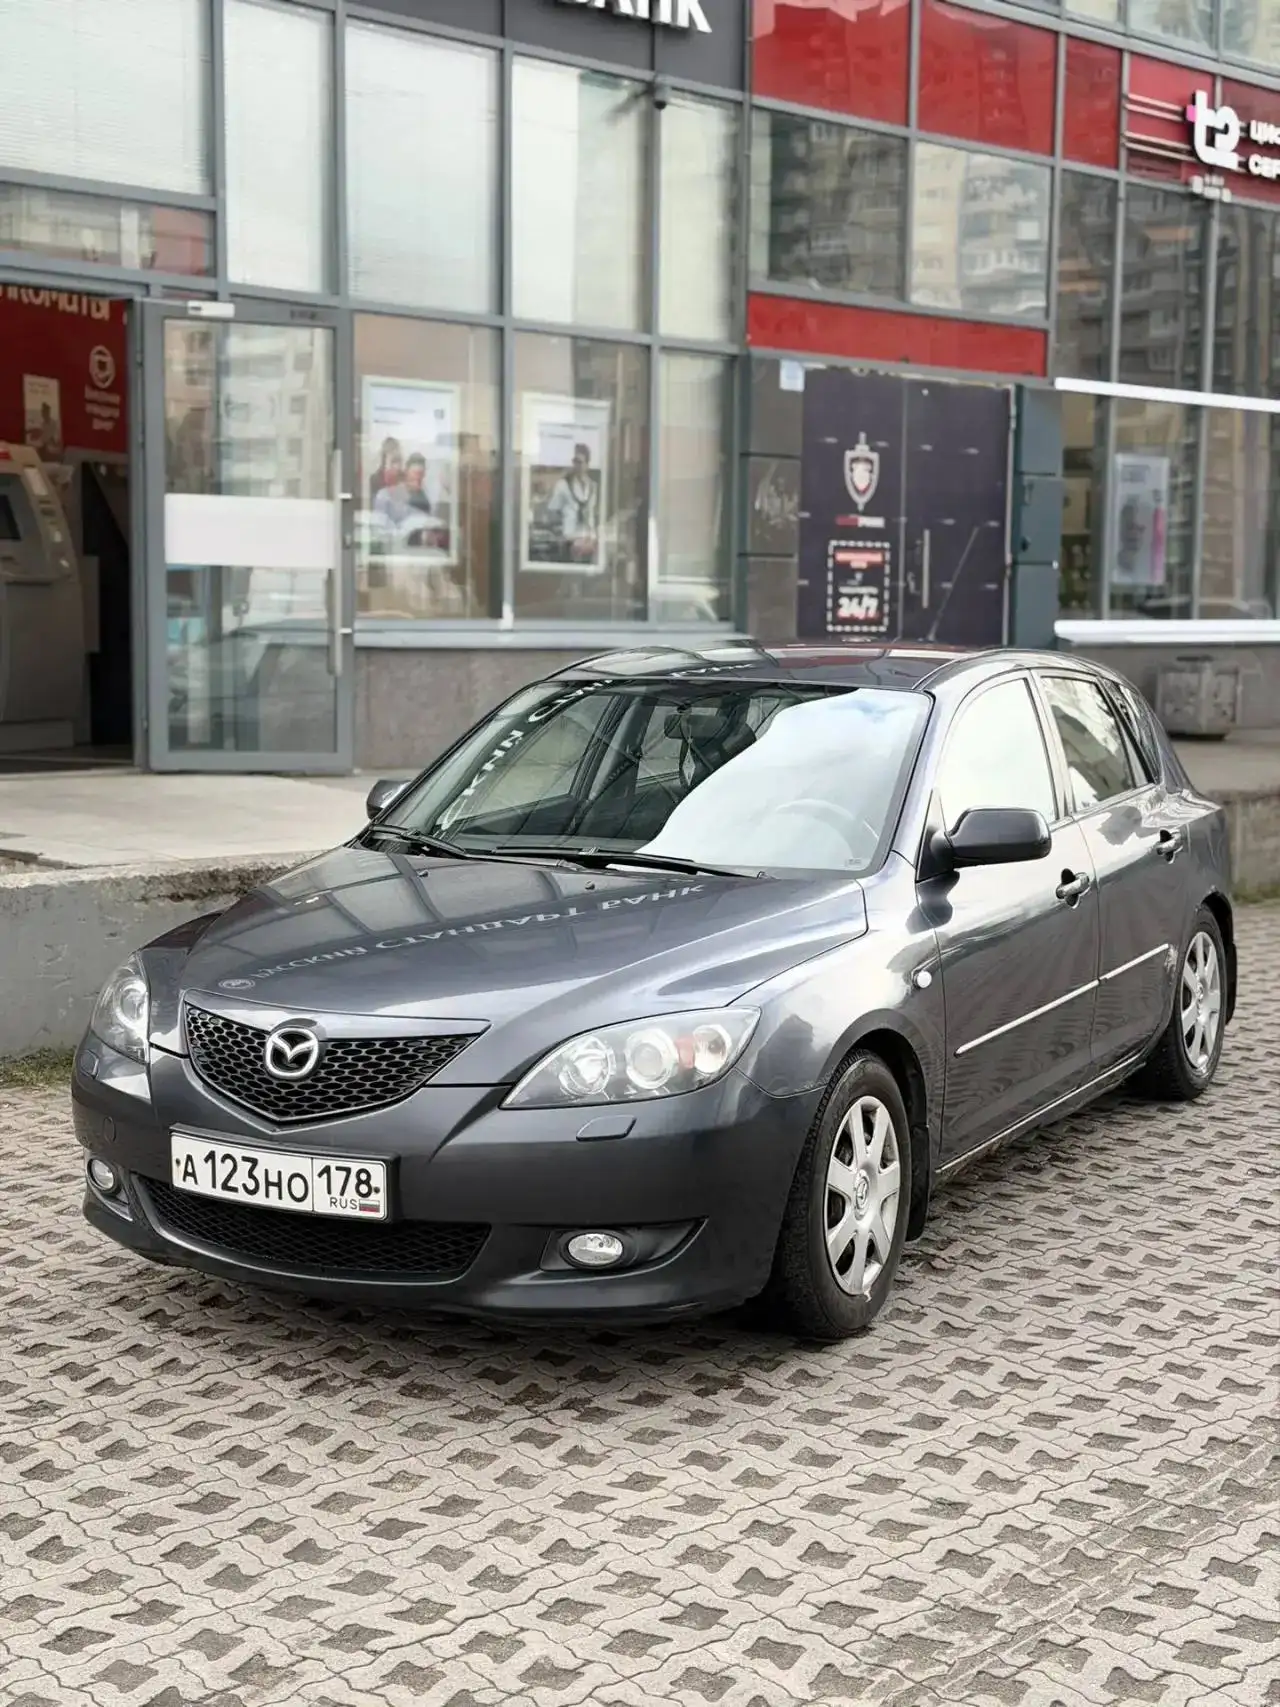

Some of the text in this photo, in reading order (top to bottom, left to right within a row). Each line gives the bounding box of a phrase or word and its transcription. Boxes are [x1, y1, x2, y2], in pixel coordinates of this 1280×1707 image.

[1186, 89, 1240, 170] t2
[317, 1164, 373, 1199] 178
[329, 1197, 358, 1210] RUS
